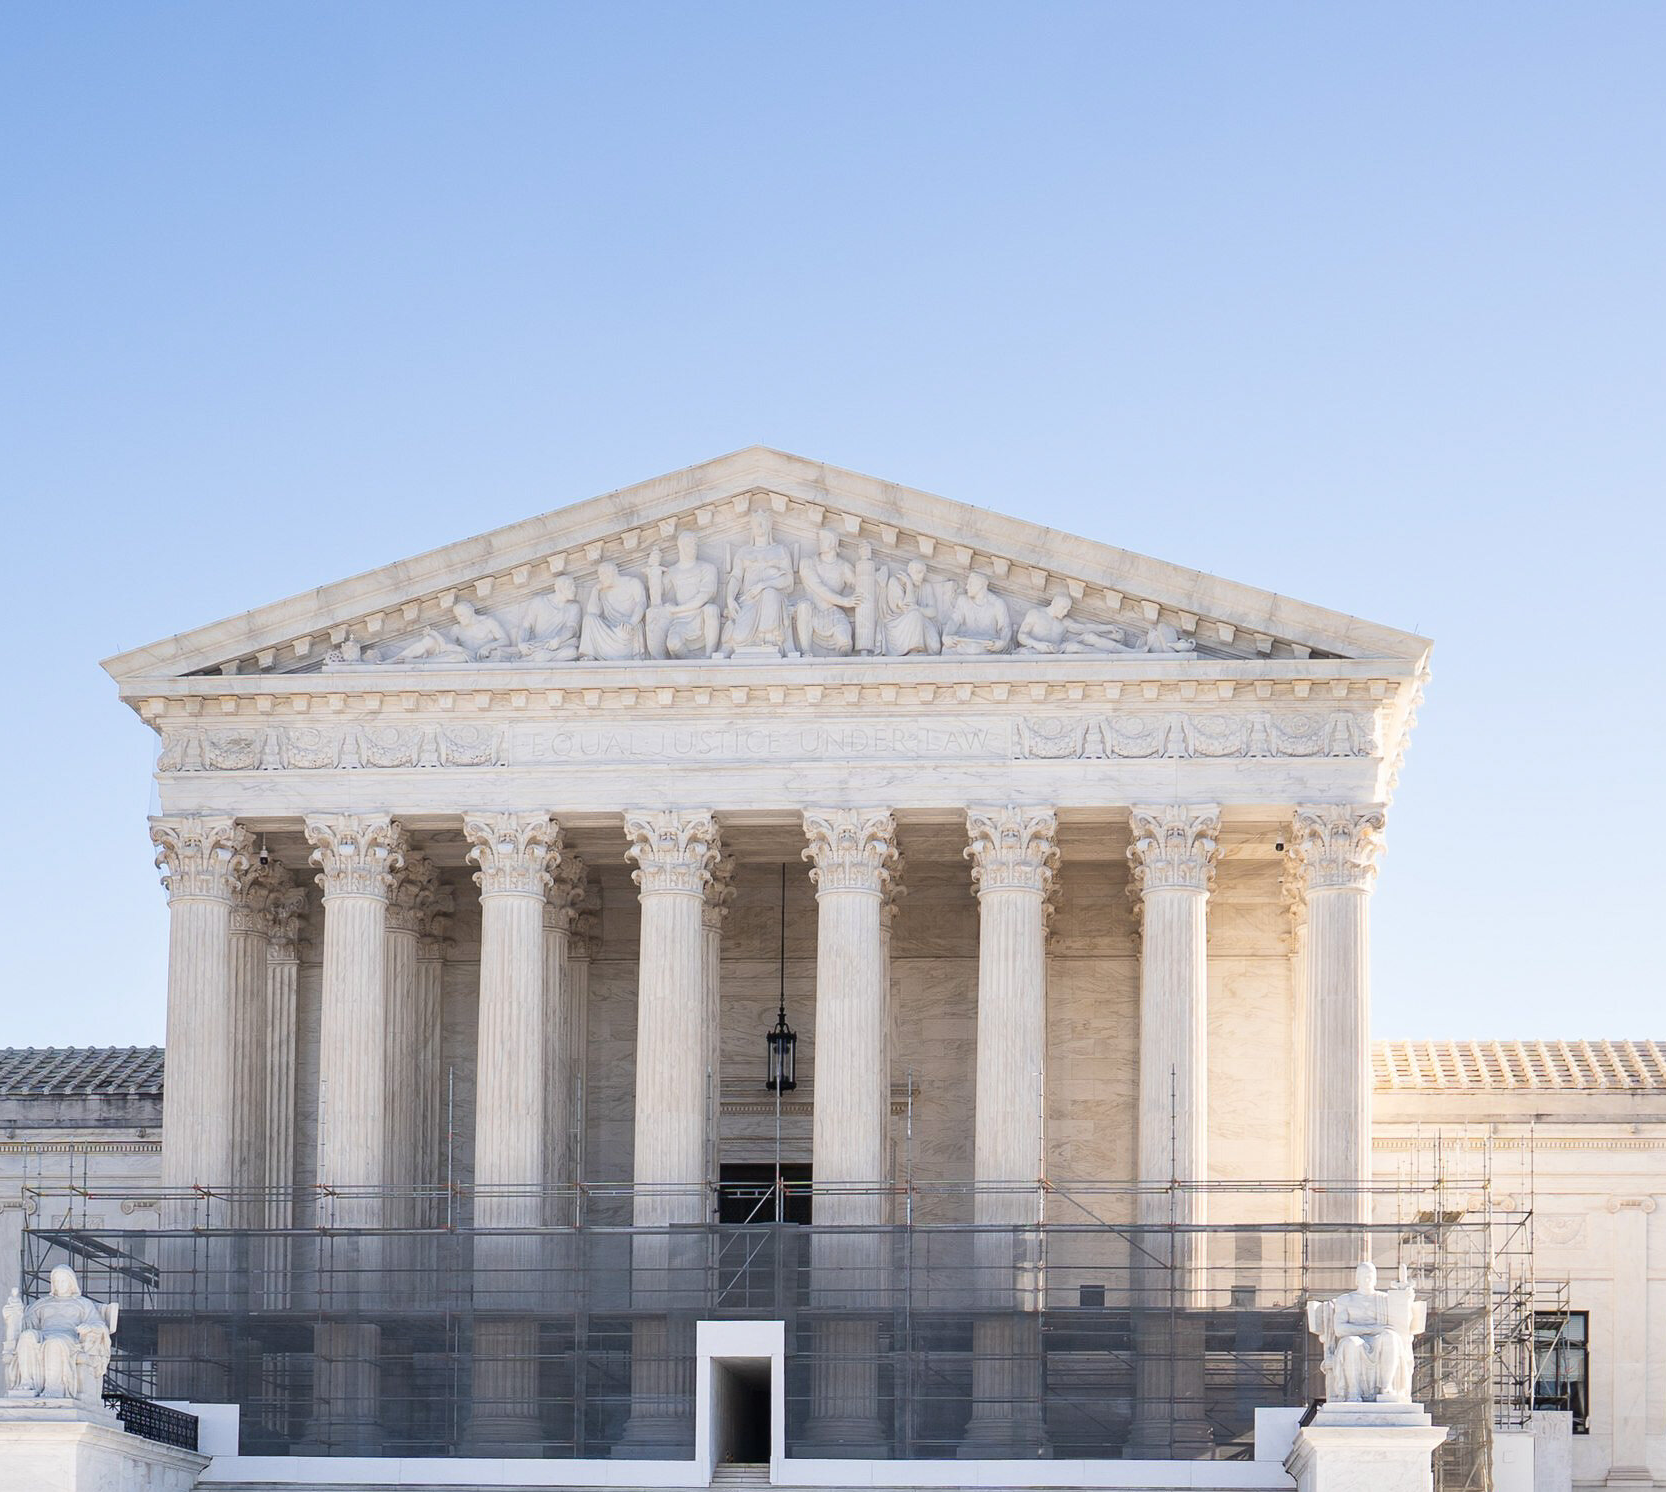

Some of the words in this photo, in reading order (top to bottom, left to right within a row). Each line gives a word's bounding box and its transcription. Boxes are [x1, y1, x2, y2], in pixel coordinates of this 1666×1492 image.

[532, 732, 642, 757] EQUAL
[652, 730, 781, 758] JUSTICE
[800, 728, 910, 753] UNDER
[925, 727, 989, 751] LAW
